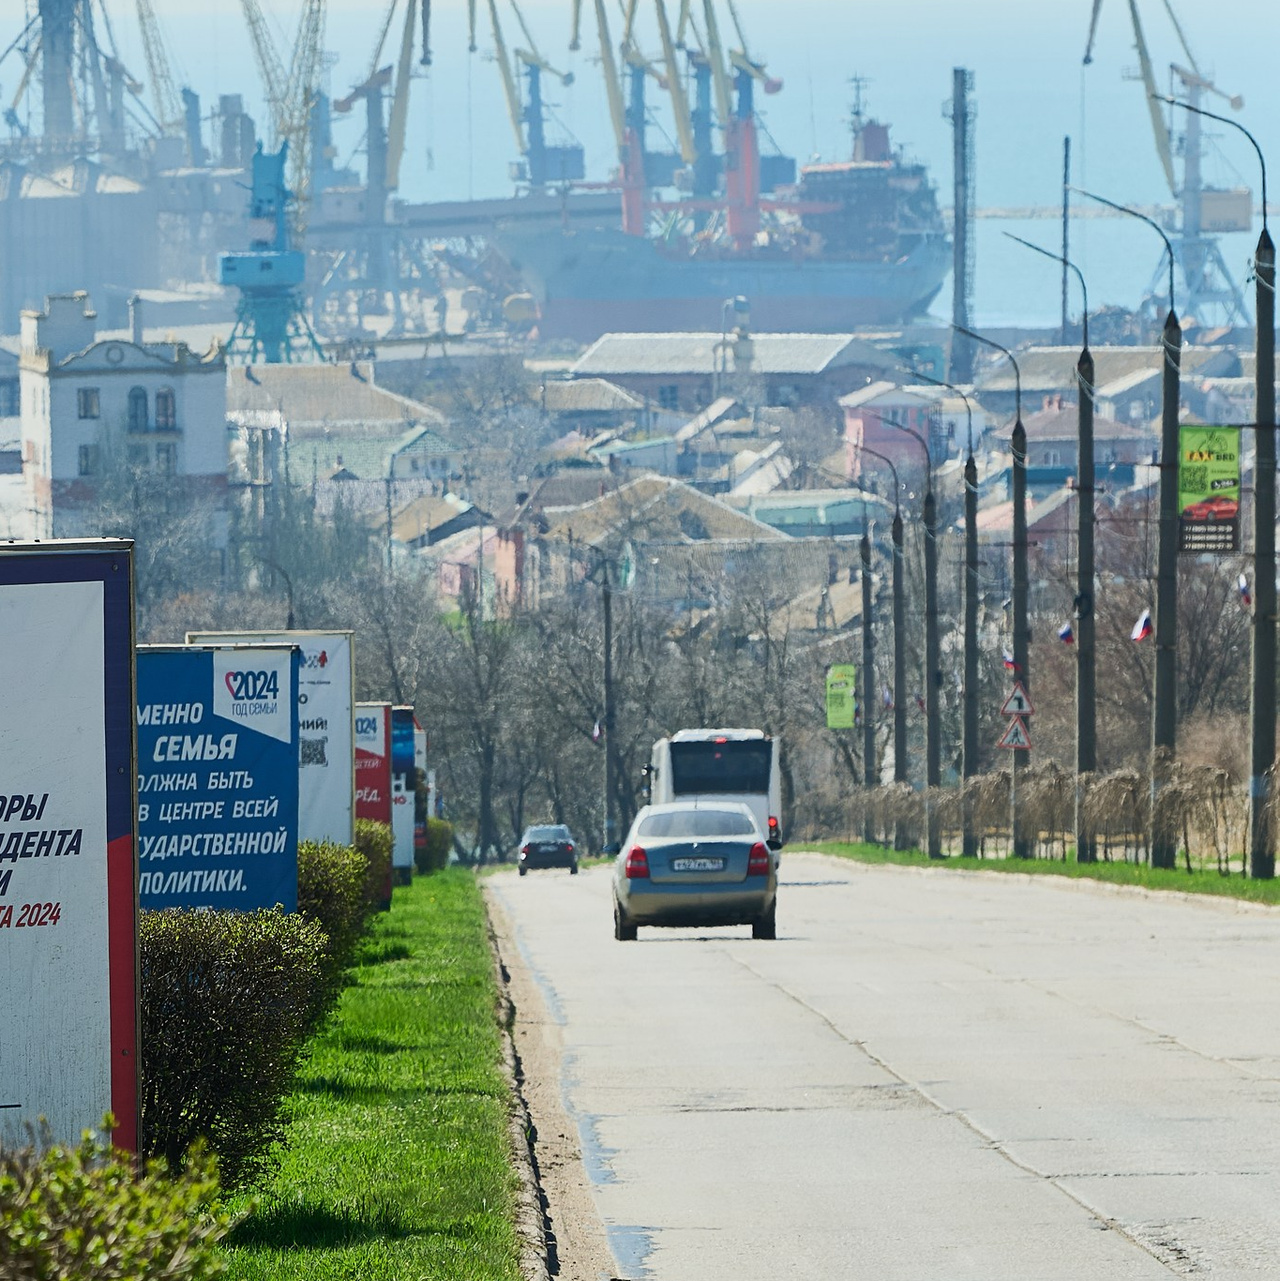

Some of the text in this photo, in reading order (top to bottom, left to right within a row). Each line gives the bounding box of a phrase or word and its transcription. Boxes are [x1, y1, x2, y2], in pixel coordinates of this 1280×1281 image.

[233, 670, 280, 701] 2024
[231, 701, 278, 718] ГОД СЕМЬИ
[153, 733, 238, 763] СЕМЬЯ
[207, 770, 254, 790] БЫТЬ
[137, 794, 279, 824] В ЦЕНТРЕ ВСЕЙ
[138, 825, 288, 862] УДАРСТВЕННОЙ
[138, 869, 248, 895] ПОЛИТИКИ.
[14, 901, 63, 929] 2024
